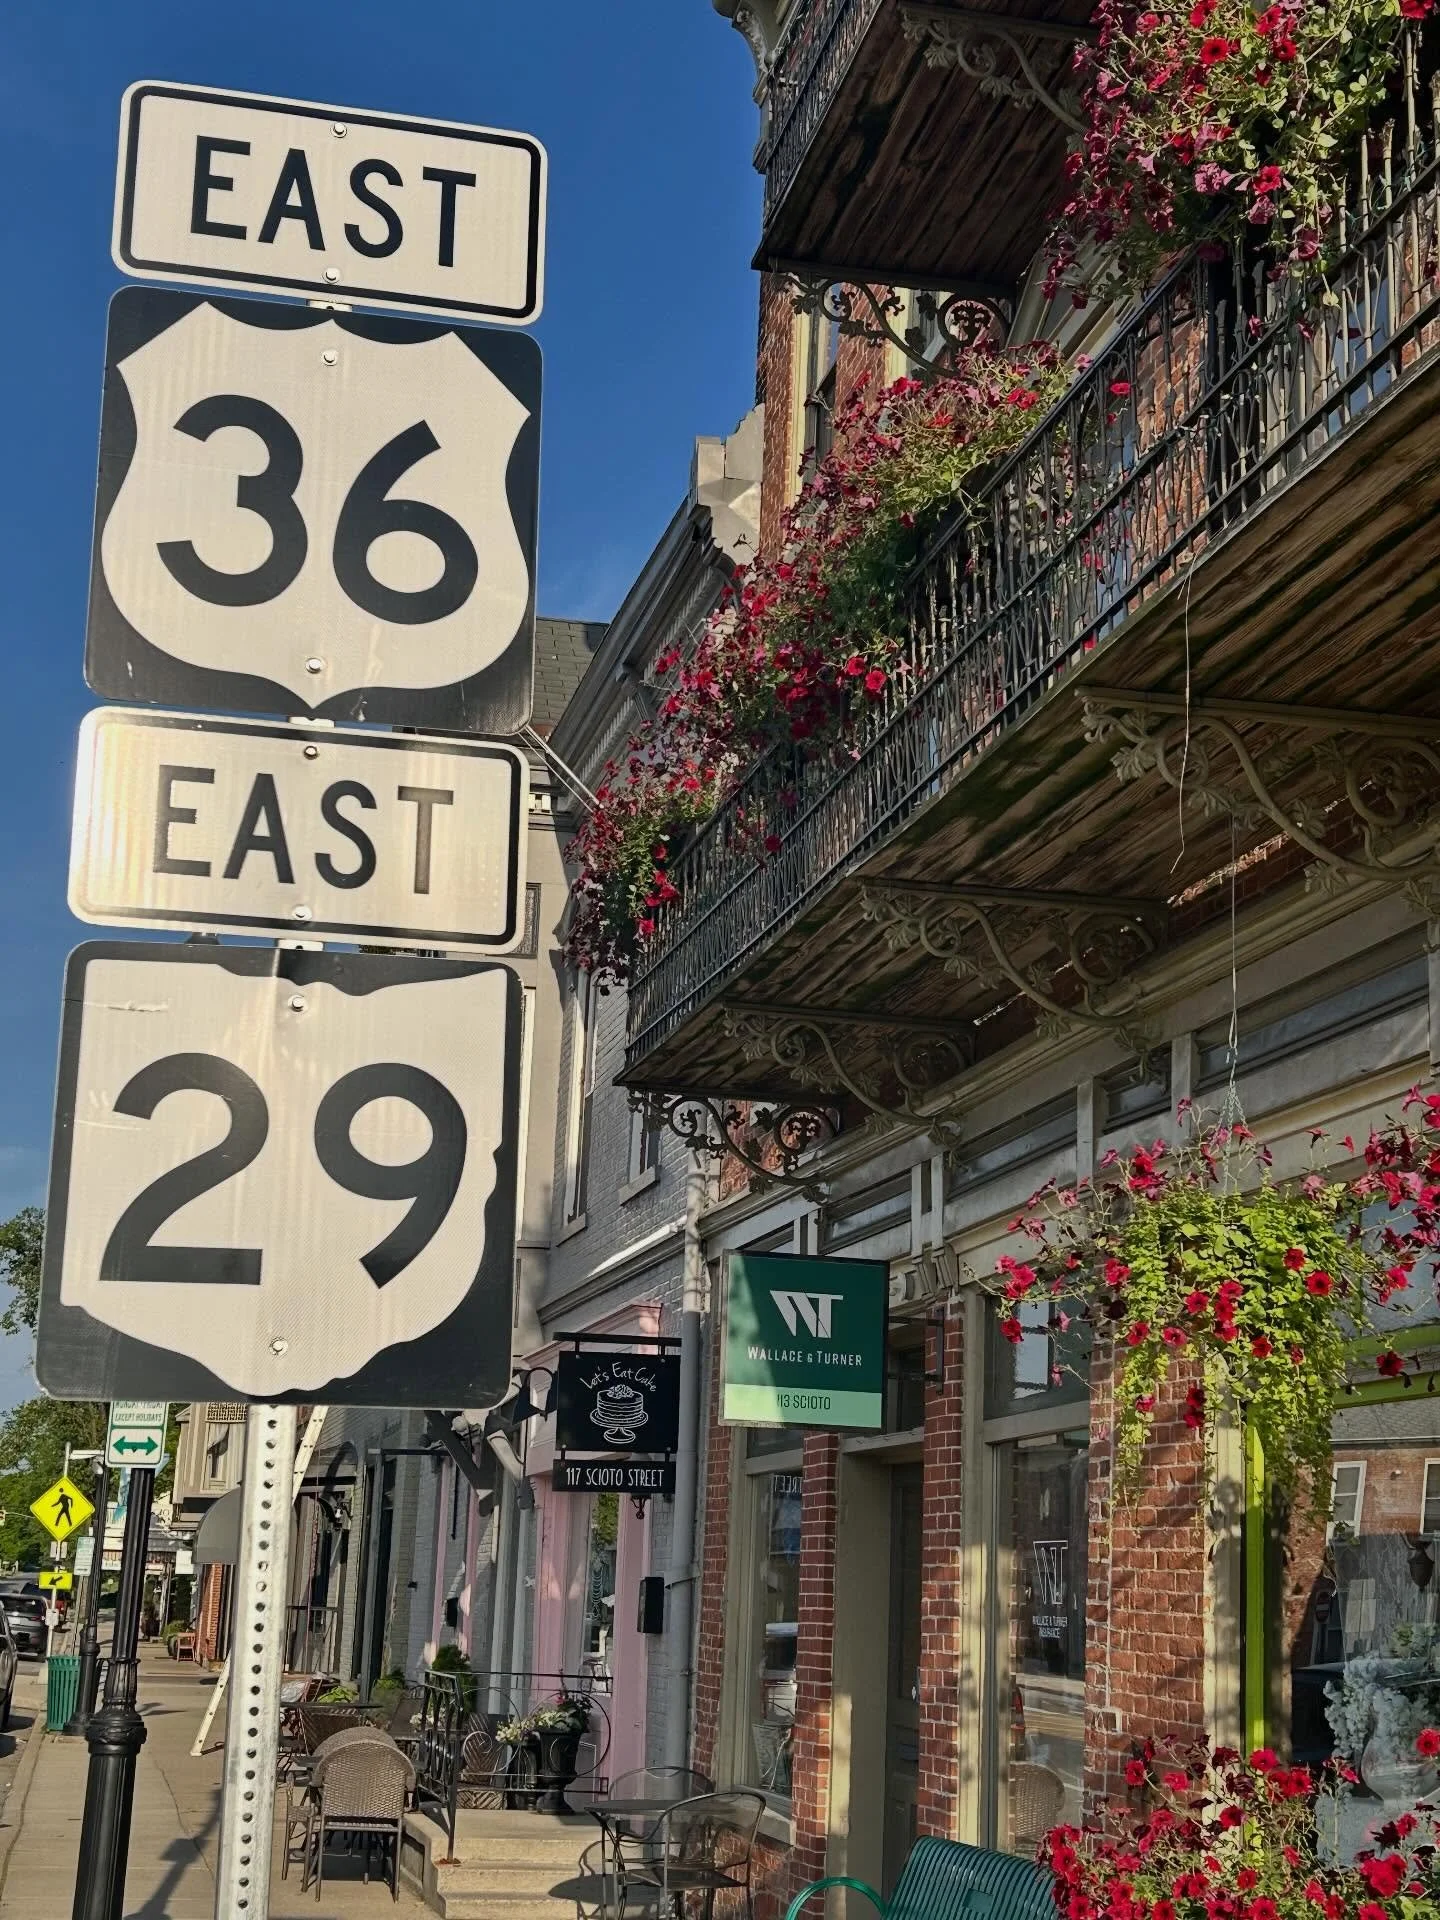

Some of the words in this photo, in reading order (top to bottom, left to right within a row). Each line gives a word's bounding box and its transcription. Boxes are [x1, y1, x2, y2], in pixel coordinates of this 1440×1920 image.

[190, 135, 475, 267] EAST
[157, 394, 478, 625] 36
[153, 764, 453, 894] EAST
[100, 1053, 467, 1289] 29
[580, 1366, 610, 1389] Let's
[612, 1362, 634, 1379] Eat
[635, 1367, 657, 1392] Cake
[748, 1346, 803, 1364] WALLACE
[816, 1350, 862, 1366] TURNER
[793, 1396, 831, 1410] SCIOTO
[566, 1467, 581, 1486] 117
[586, 1468, 623, 1486] SCIOTO
[628, 1469, 664, 1487] STREET
